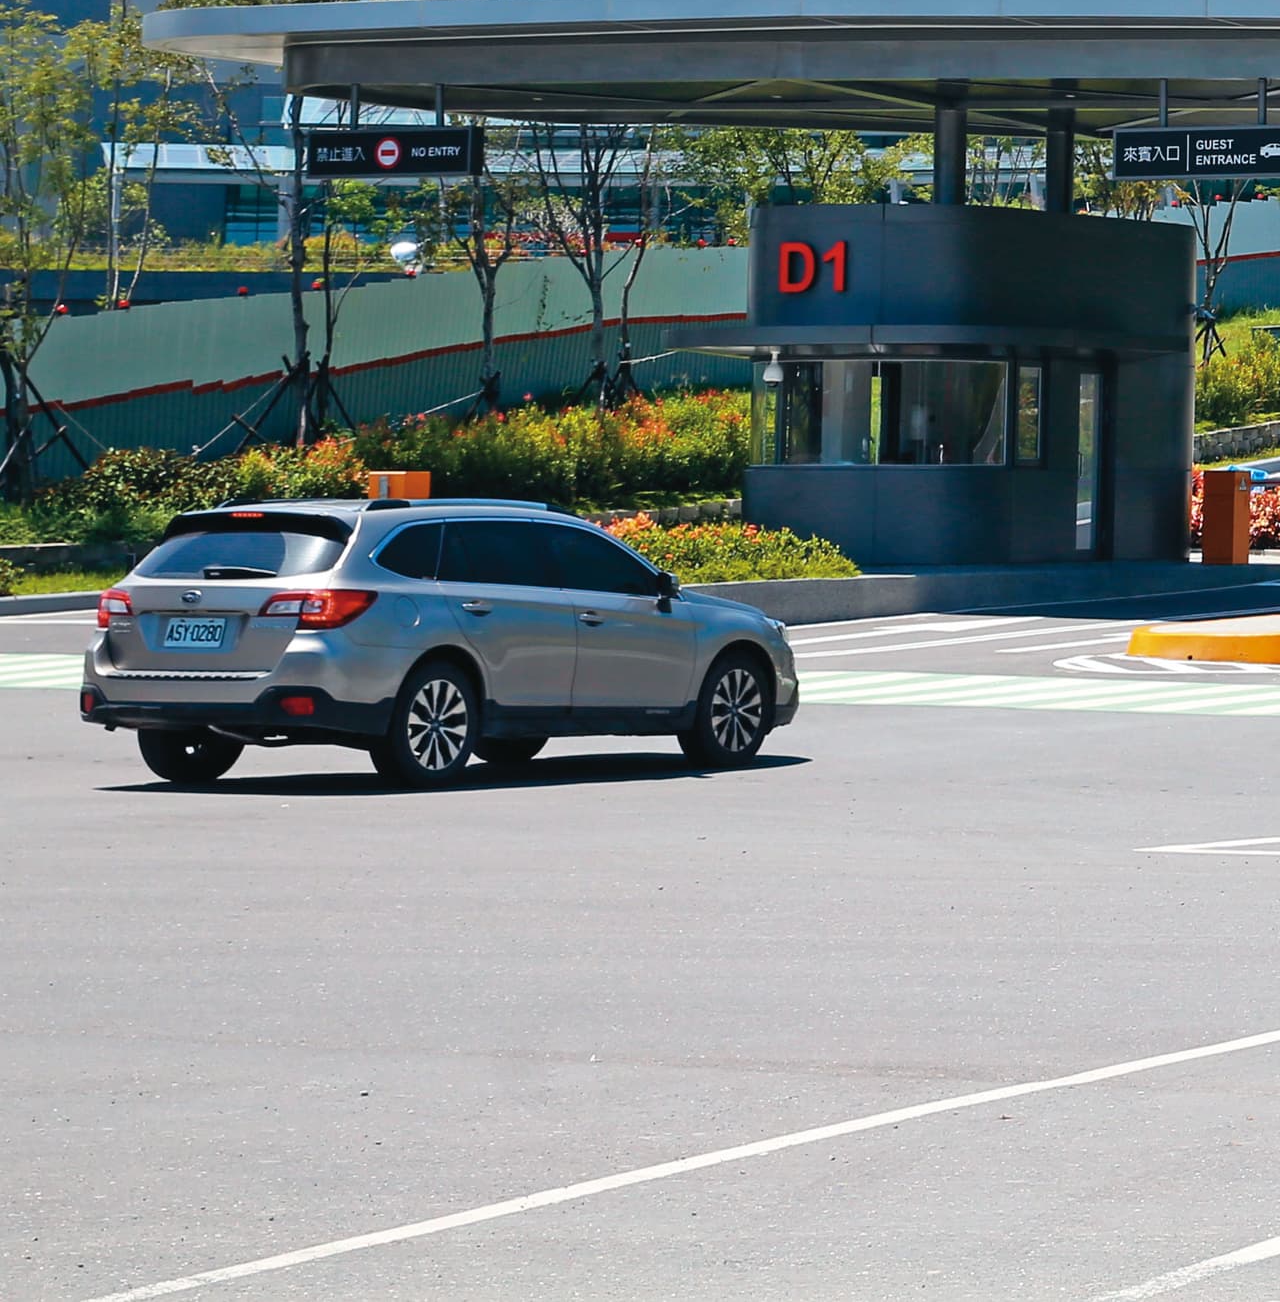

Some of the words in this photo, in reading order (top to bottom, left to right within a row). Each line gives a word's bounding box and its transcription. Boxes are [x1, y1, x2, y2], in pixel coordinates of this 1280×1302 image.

[411, 147, 426, 157] NO
[428, 146, 461, 157] ENTRY
[1195, 139, 1235, 151] GUEST
[316, 146, 366, 162] 禁止進入
[1123, 145, 1180, 162] 來賓入口
[1195, 153, 1257, 166] ENTRANCE
[778, 240, 847, 294] D1
[166, 623, 223, 643] ASY-0280
